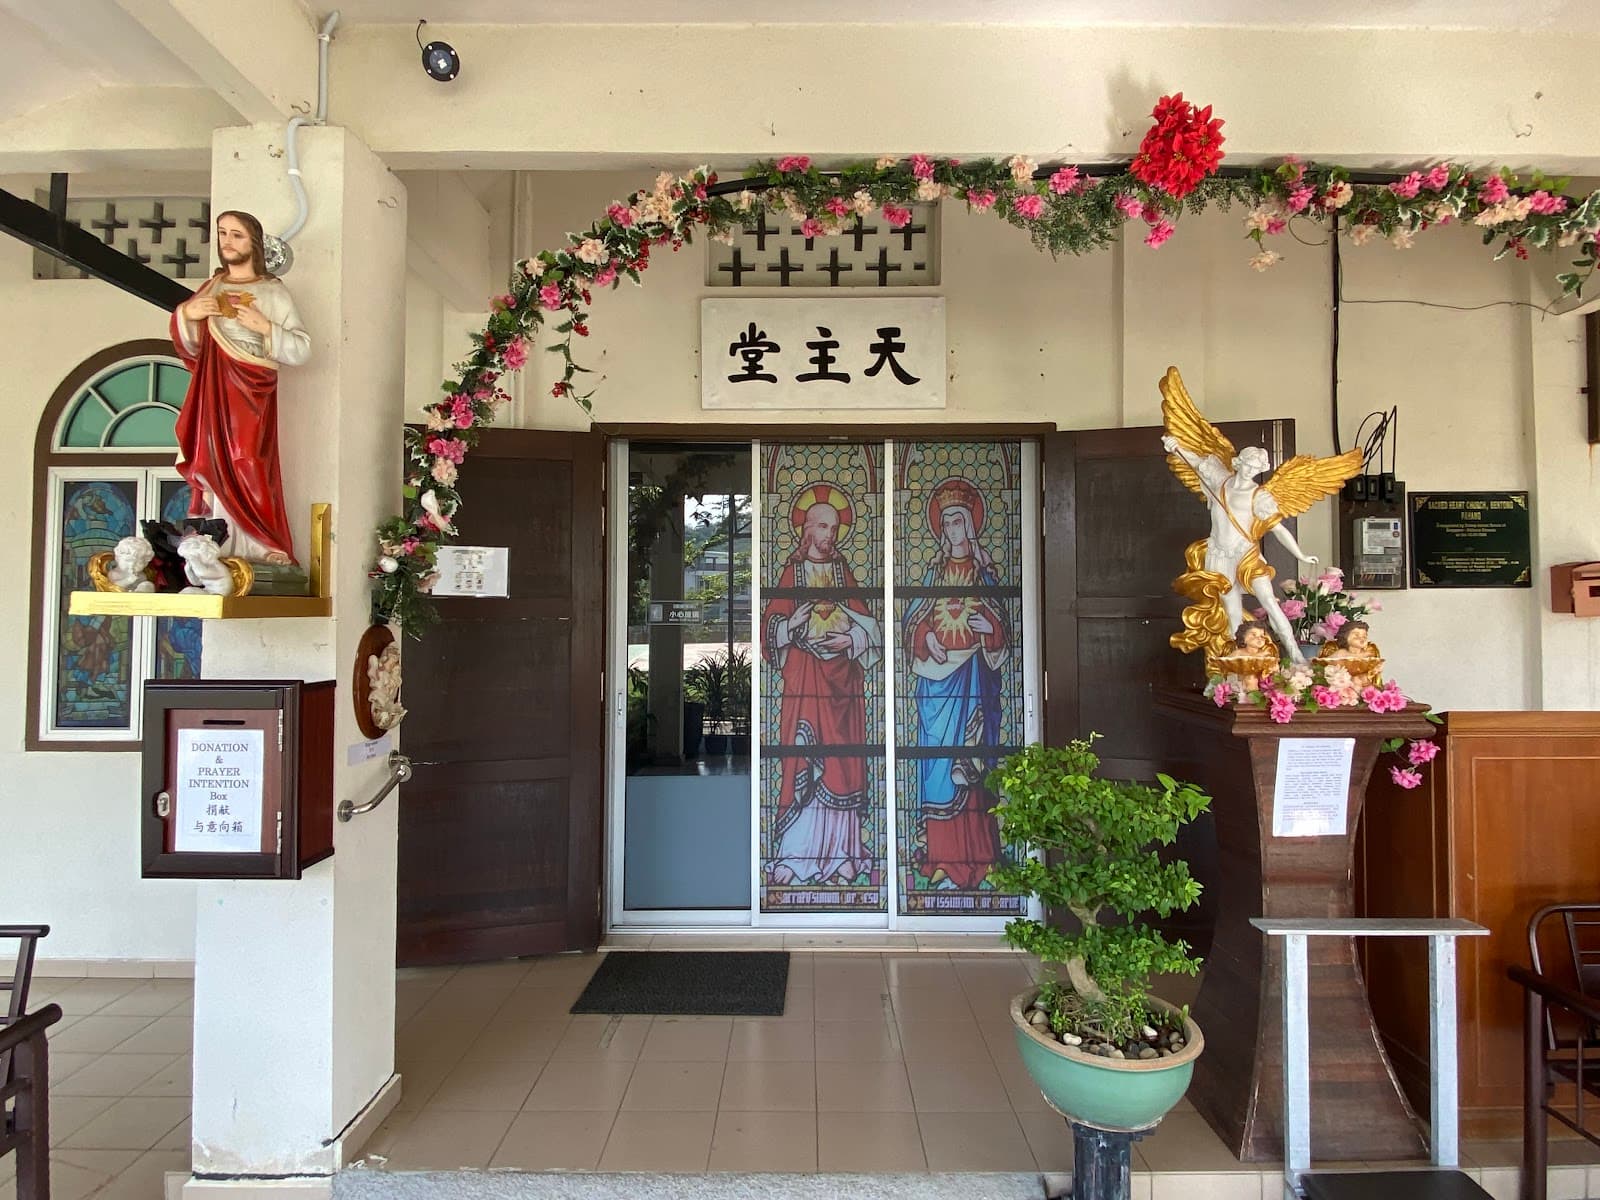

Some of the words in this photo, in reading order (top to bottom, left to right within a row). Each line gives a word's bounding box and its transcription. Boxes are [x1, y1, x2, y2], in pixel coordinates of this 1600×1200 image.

[191, 743, 249, 752] DONATION
[215, 756, 224, 765] &
[198, 767, 240, 776] PRAYER
[188, 779, 249, 789] INTENTION
[210, 791, 228, 801] Box
[206, 804, 231, 816] 捐献
[193, 820, 243, 833] 与意向箱
